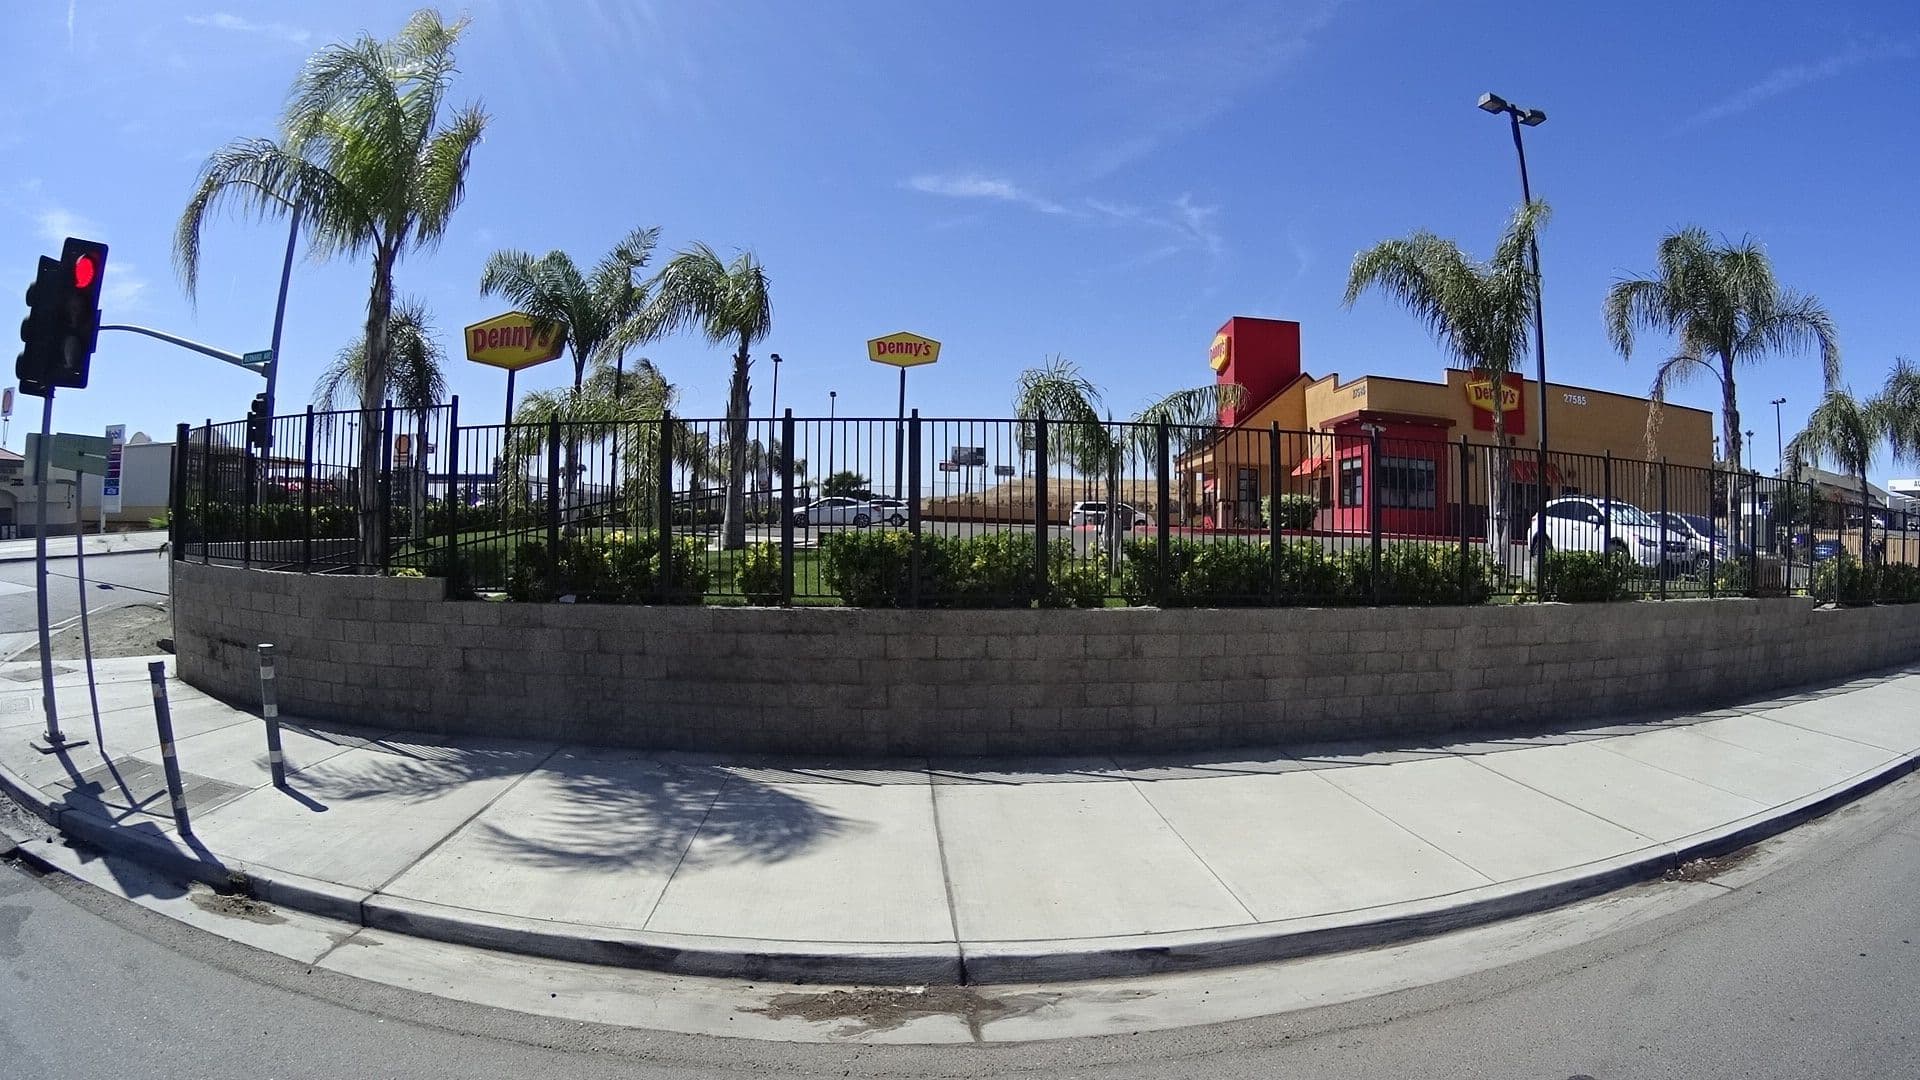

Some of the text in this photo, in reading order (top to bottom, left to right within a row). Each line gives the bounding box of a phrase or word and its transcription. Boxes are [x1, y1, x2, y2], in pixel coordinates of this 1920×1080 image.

[472, 325, 549, 354] Dennys
[876, 341, 931, 357] Denny's
[1474, 386, 1515, 405] Deny's
[1563, 393, 1587, 406] 27585
